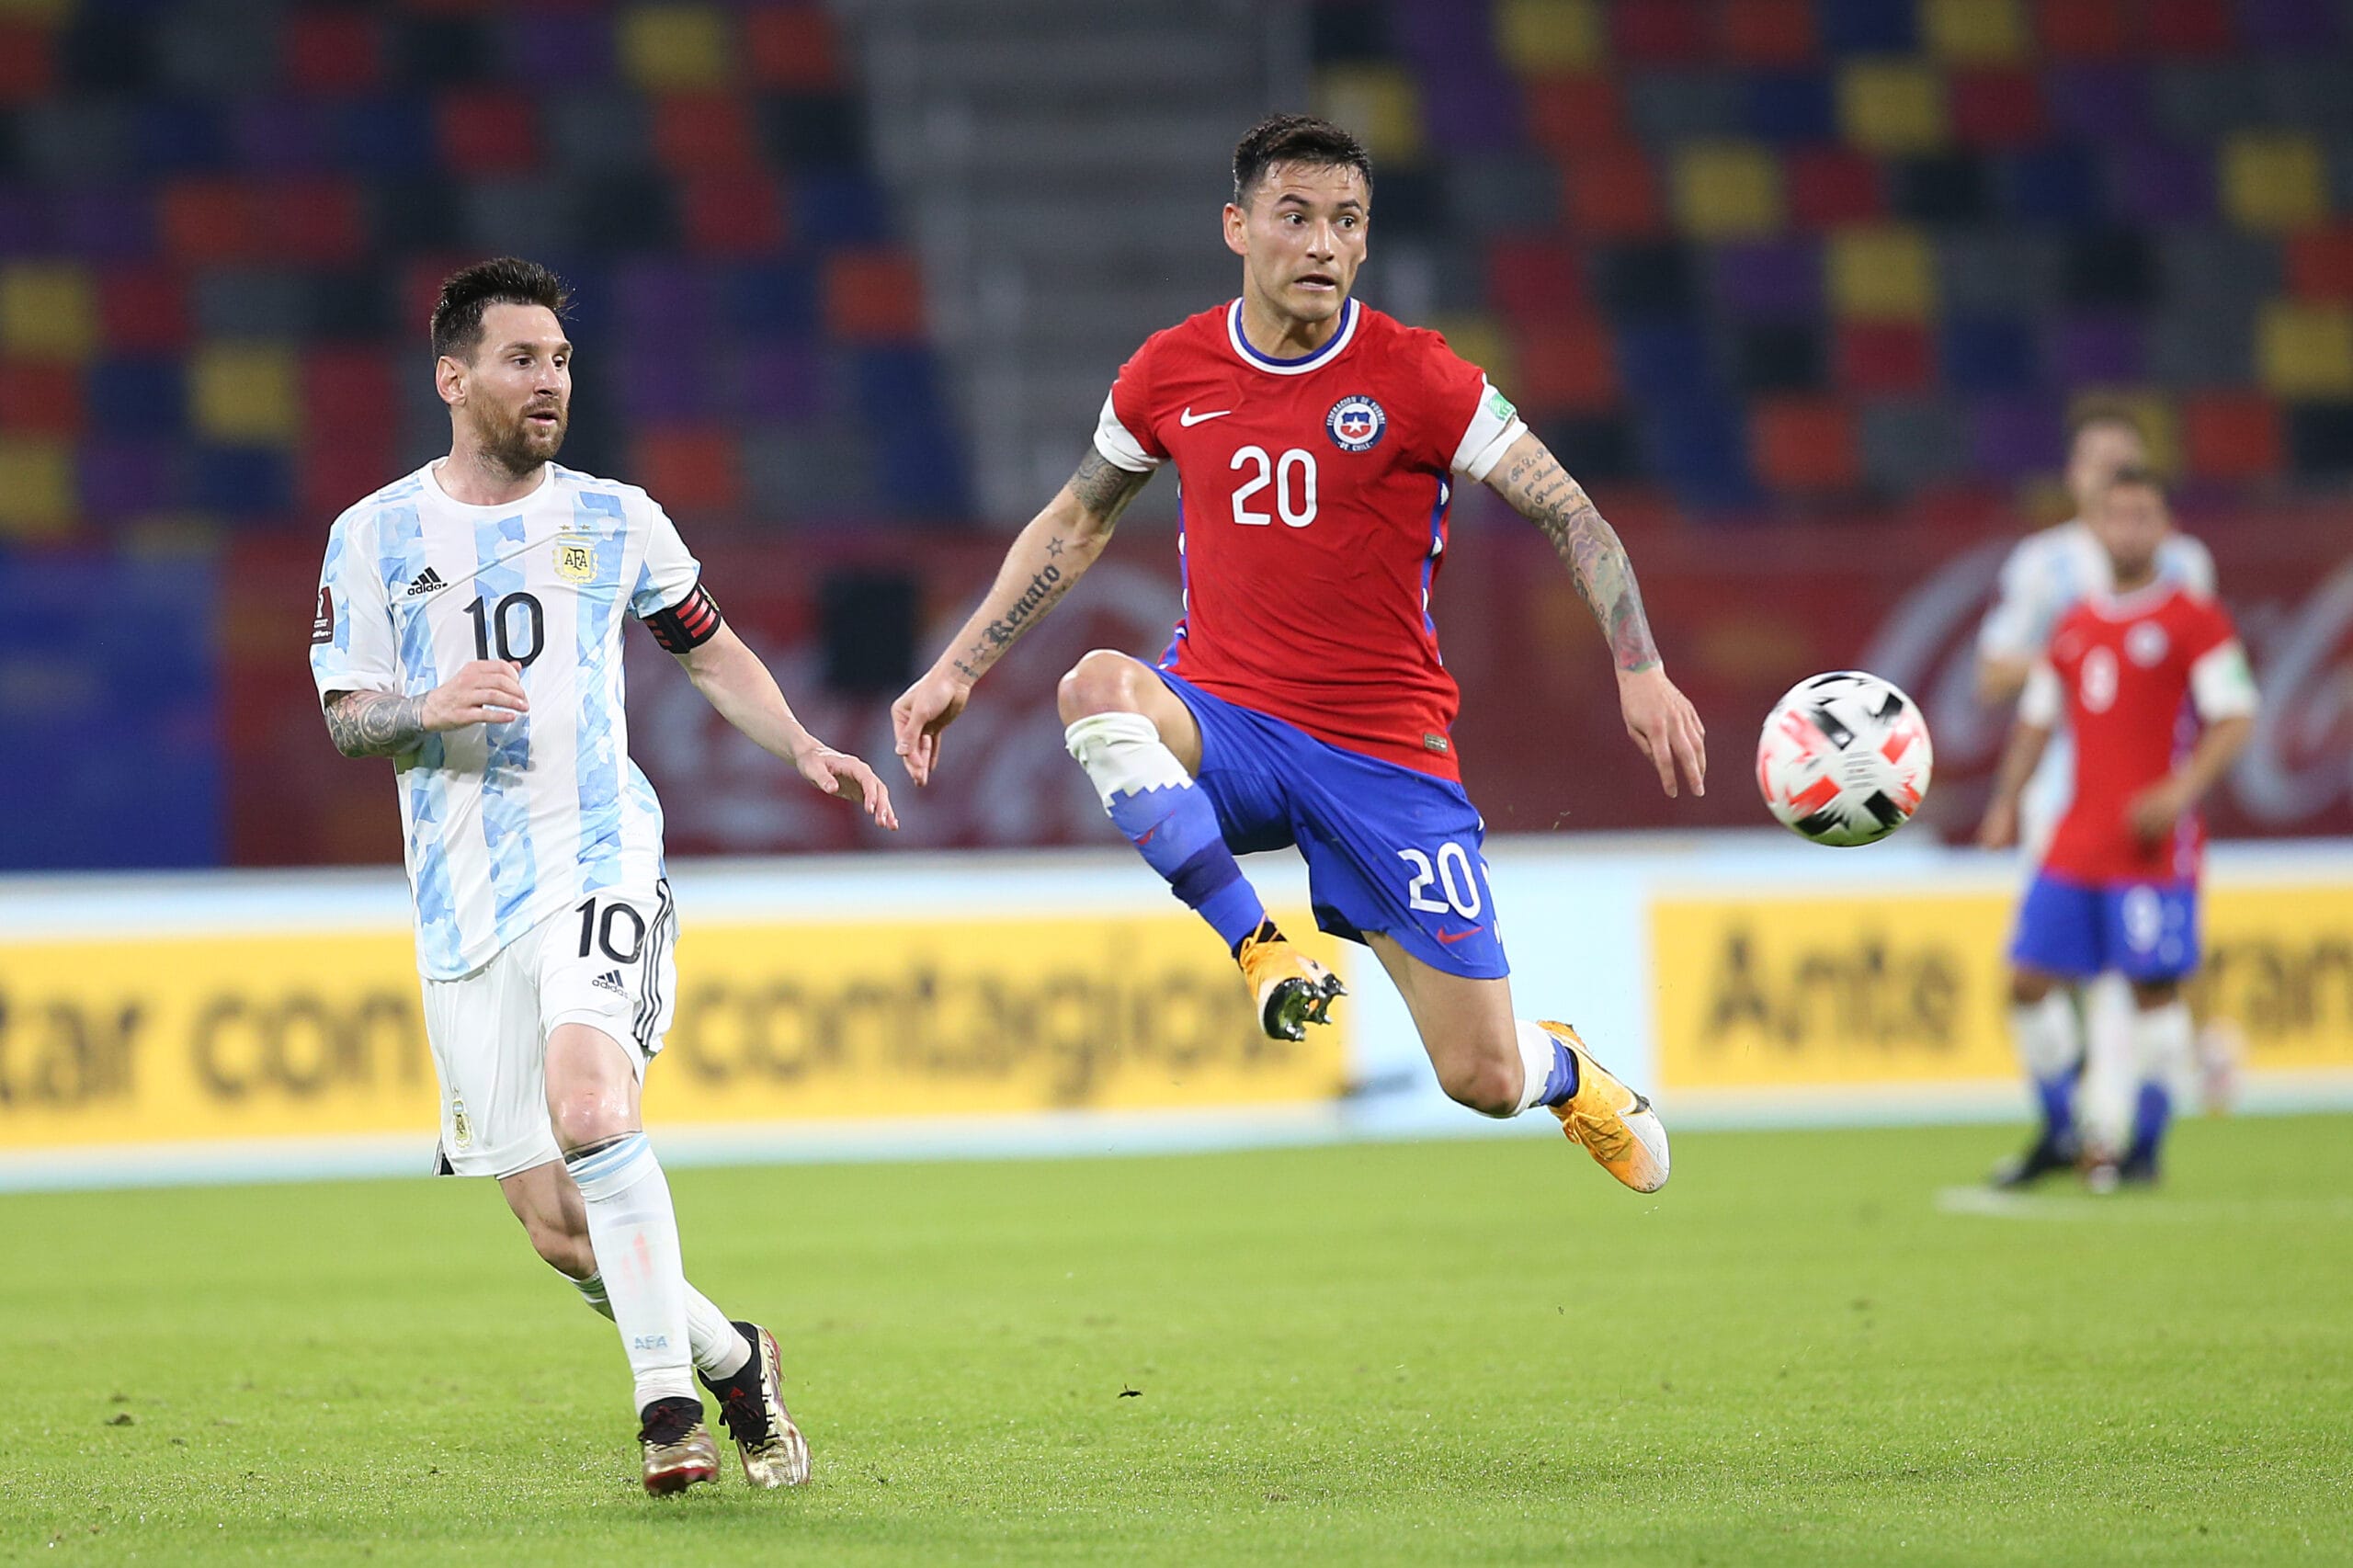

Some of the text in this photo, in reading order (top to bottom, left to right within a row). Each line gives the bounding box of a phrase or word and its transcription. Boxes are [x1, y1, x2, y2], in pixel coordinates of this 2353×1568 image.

[1230, 445, 1318, 528] 20
[563, 548, 588, 571] AFA
[462, 592, 544, 669] 10
[983, 564, 1061, 645] Renato
[1397, 842, 1481, 919] 20
[576, 897, 645, 964] 10
[592, 980, 629, 999] adidas
[1701, 913, 1966, 1051] Ante
